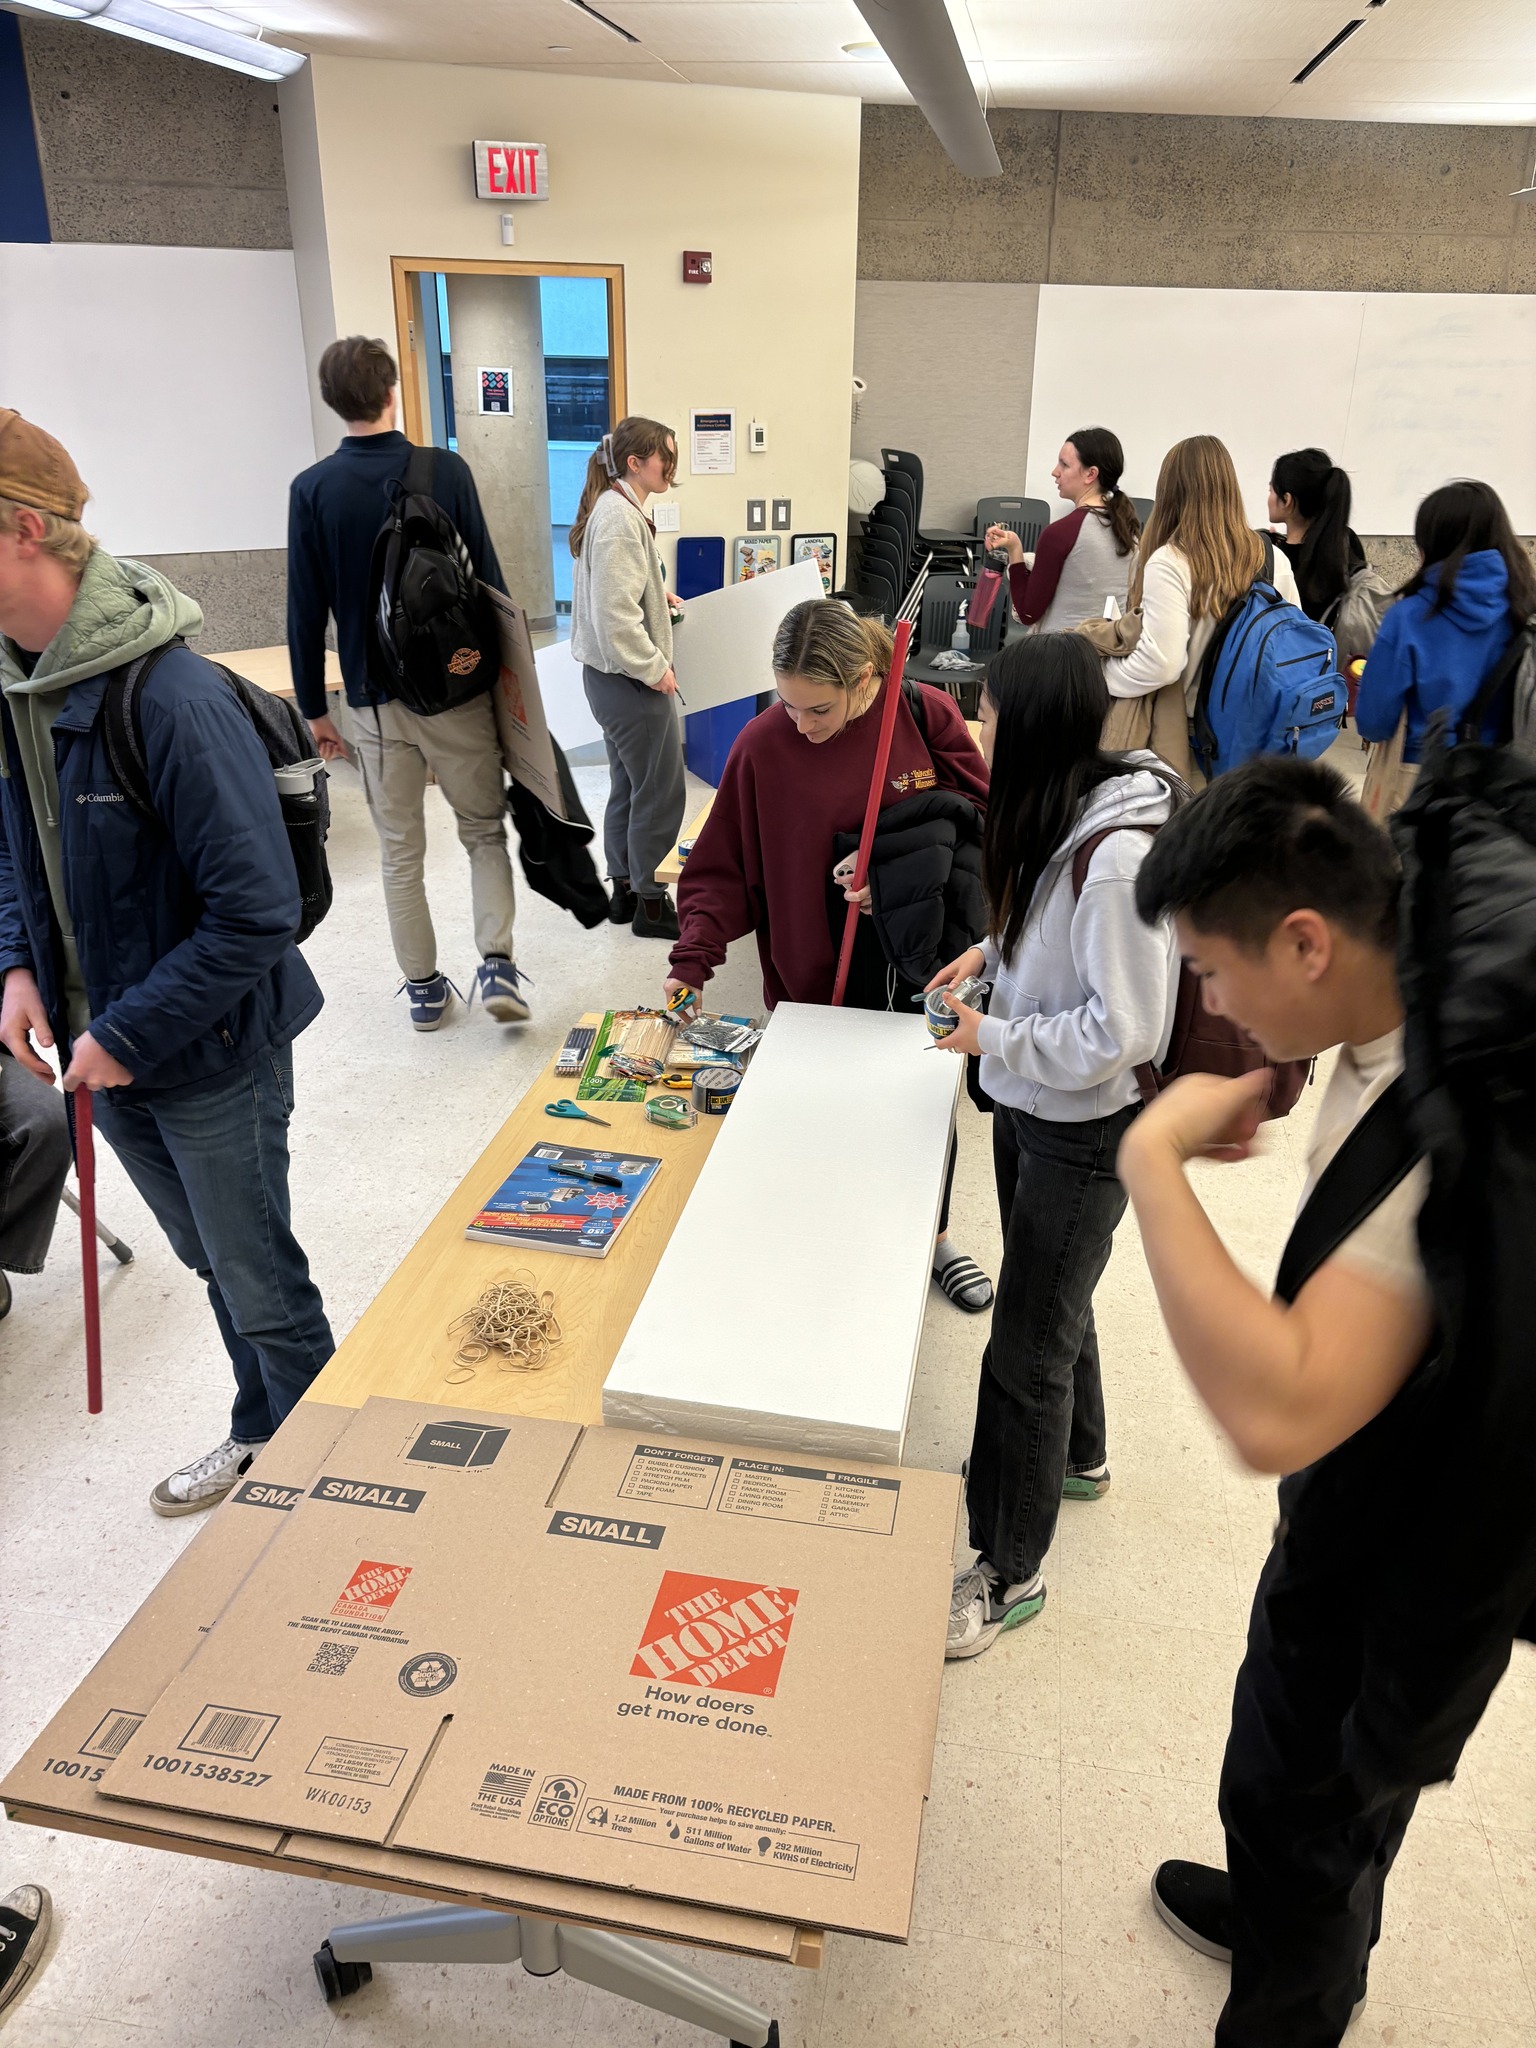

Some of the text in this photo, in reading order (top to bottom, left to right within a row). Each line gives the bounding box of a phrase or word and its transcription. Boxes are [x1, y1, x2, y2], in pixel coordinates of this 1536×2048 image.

[488, 147, 538, 194] EXIT
[86, 793, 124, 802] Columbia
[430, 1440, 461, 1449] SMALL
[644, 1448, 714, 1463] DON'T FORGET:
[738, 1461, 769, 1471] PLACE
[838, 1475, 879, 1485] FRAGILE
[741, 1486, 766, 1494] FAMILY
[743, 1480, 777, 1488] BEDROOM
[245, 1486, 303, 1506] SMA
[322, 1481, 410, 1508] SMALL
[832, 1499, 870, 1508] BASEMENT
[560, 1516, 651, 1544] SMALL
[358, 1566, 384, 1581] THE
[344, 1566, 409, 1601] HOME
[361, 1581, 403, 1604] DEPOT
[334, 1607, 384, 1621] FOUNDATION
[336, 1601, 368, 1612] CANADA
[664, 1588, 728, 1626] THE
[301, 1615, 319, 1623] SCAN
[340, 1621, 360, 1630] LEARN
[362, 1624, 381, 1633] MORE
[381, 1628, 404, 1636] ABOUT
[637, 1585, 796, 1680] HOME
[342, 1630, 368, 1638] CANADA
[369, 1634, 409, 1645] FOUNDATION
[689, 1626, 787, 1687] DEPOT
[644, 1685, 755, 1715] How doers
[617, 1702, 652, 1717] get
[656, 1708, 709, 1727] more
[323, 1746, 354, 1754] GUARANTEED
[360, 1746, 392, 1754] COMPONENTS
[42, 1758, 106, 1782] 10015
[142, 1754, 272, 1787] 1001538527
[345, 1766, 381, 1775] INDUSTRIES
[489, 1763, 536, 1777] MADE IN
[306, 1787, 371, 1814] WK00153
[477, 1792, 522, 1807] THE USA
[536, 1800, 574, 1818] ECO
[614, 1785, 836, 1833] MADE FROM 100% RECYCLED PAPER.
[533, 1814, 569, 1827] OPTIONS
[611, 1823, 633, 1833] Trees
[629, 1817, 657, 1828] Million
[660, 1807, 676, 1816] Your
[676, 1811, 708, 1822] purchase
[709, 1816, 728, 1825] helps
[755, 1824, 786, 1835] annually:
[686, 1827, 732, 1841] 511 Million
[683, 1836, 752, 1854] Gallons of Water
[775, 1842, 822, 1857] 292 Million
[773, 1851, 799, 1862] KWHS
[810, 1858, 854, 1873] Electricity
